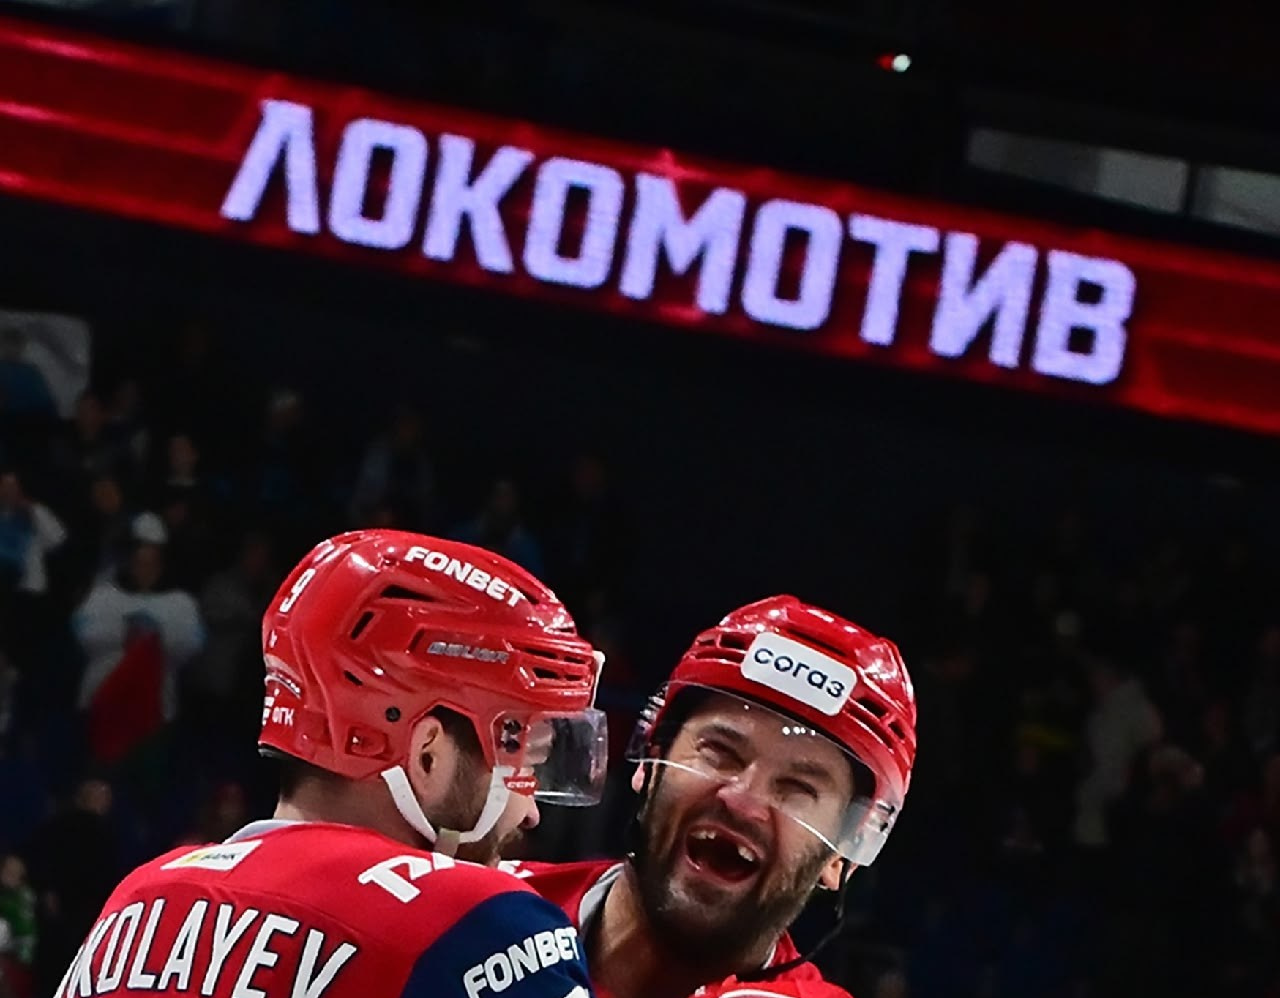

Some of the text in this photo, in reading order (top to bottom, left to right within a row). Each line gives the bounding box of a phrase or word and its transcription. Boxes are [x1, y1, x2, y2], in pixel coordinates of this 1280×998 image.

[221, 99, 1137, 386] ЛОКОМОТИВ
[278, 568, 317, 614] 9
[404, 546, 528, 609] FONBET
[754, 647, 846, 699] согаз
